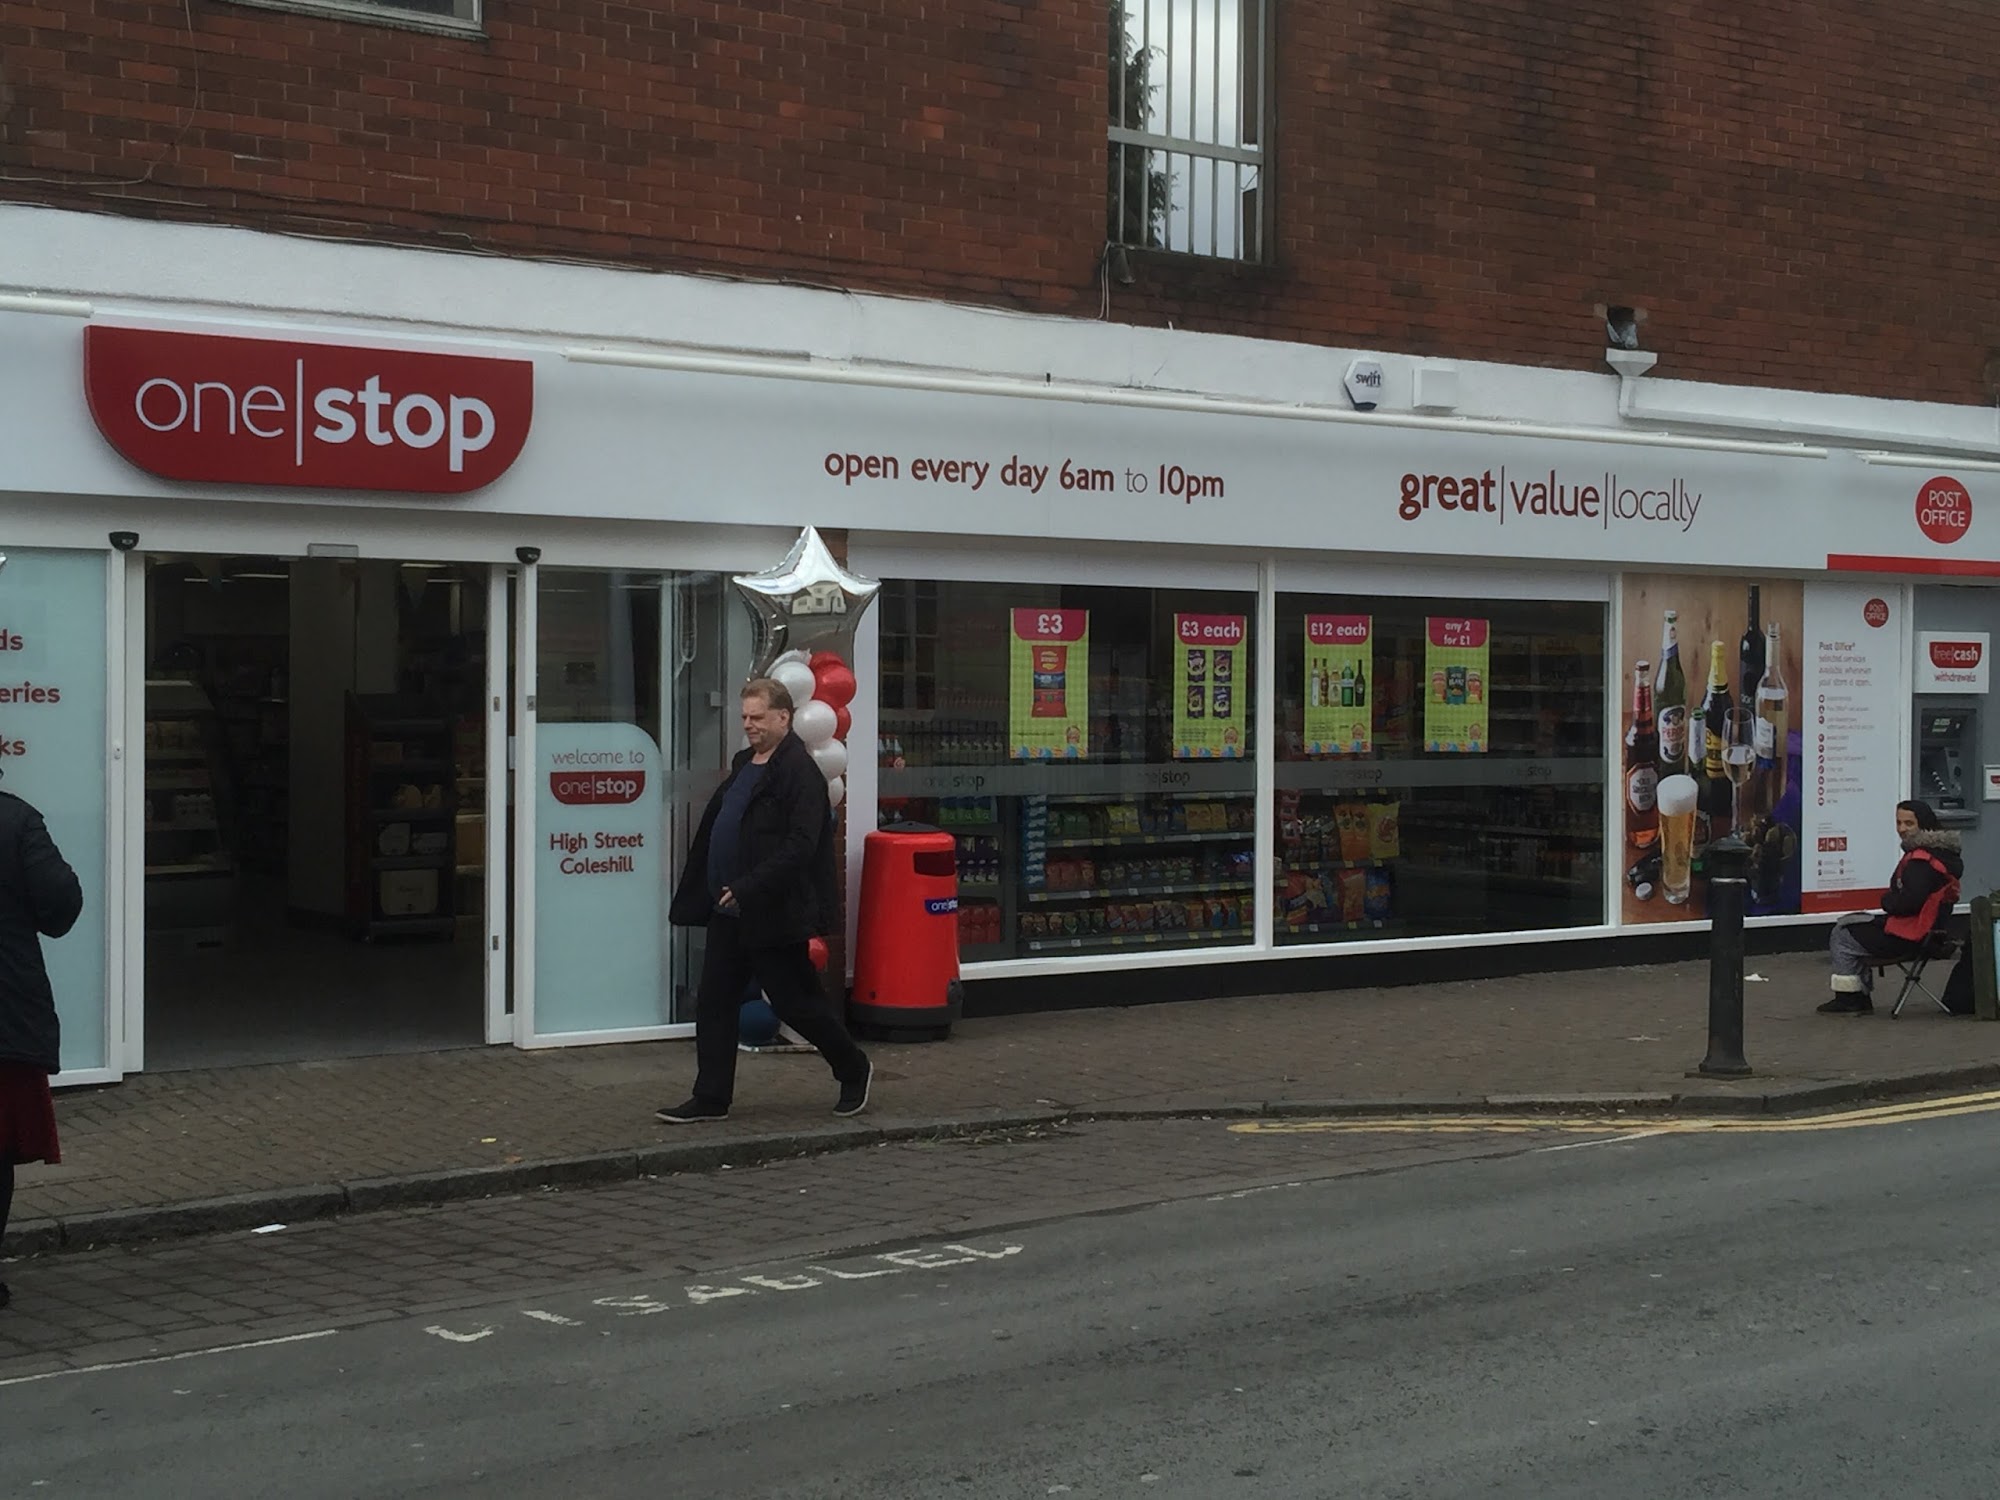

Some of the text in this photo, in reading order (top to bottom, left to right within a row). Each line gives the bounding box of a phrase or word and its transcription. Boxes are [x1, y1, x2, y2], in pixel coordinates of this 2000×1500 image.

[1355, 370, 1382, 387] swift
[134, 374, 497, 473] one stop
[824, 452, 1225, 505] open every day 6am to 10pm
[1398, 469, 1703, 533] great value locally
[1928, 490, 1962, 508] POST
[1920, 508, 1966, 528] OFFICE
[1037, 613, 1063, 634] £3
[1180, 620, 1241, 638] £3 each
[1310, 622, 1367, 637] £12 each
[1444, 620, 1471, 633] any 2
[1443, 634, 1471, 646] for £1
[1954, 647, 1978, 662] cash
[0, 681, 61, 704] eries
[551, 748, 645, 765] welcome to
[550, 831, 644, 854] High Street
[560, 855, 634, 875] Coleshill
